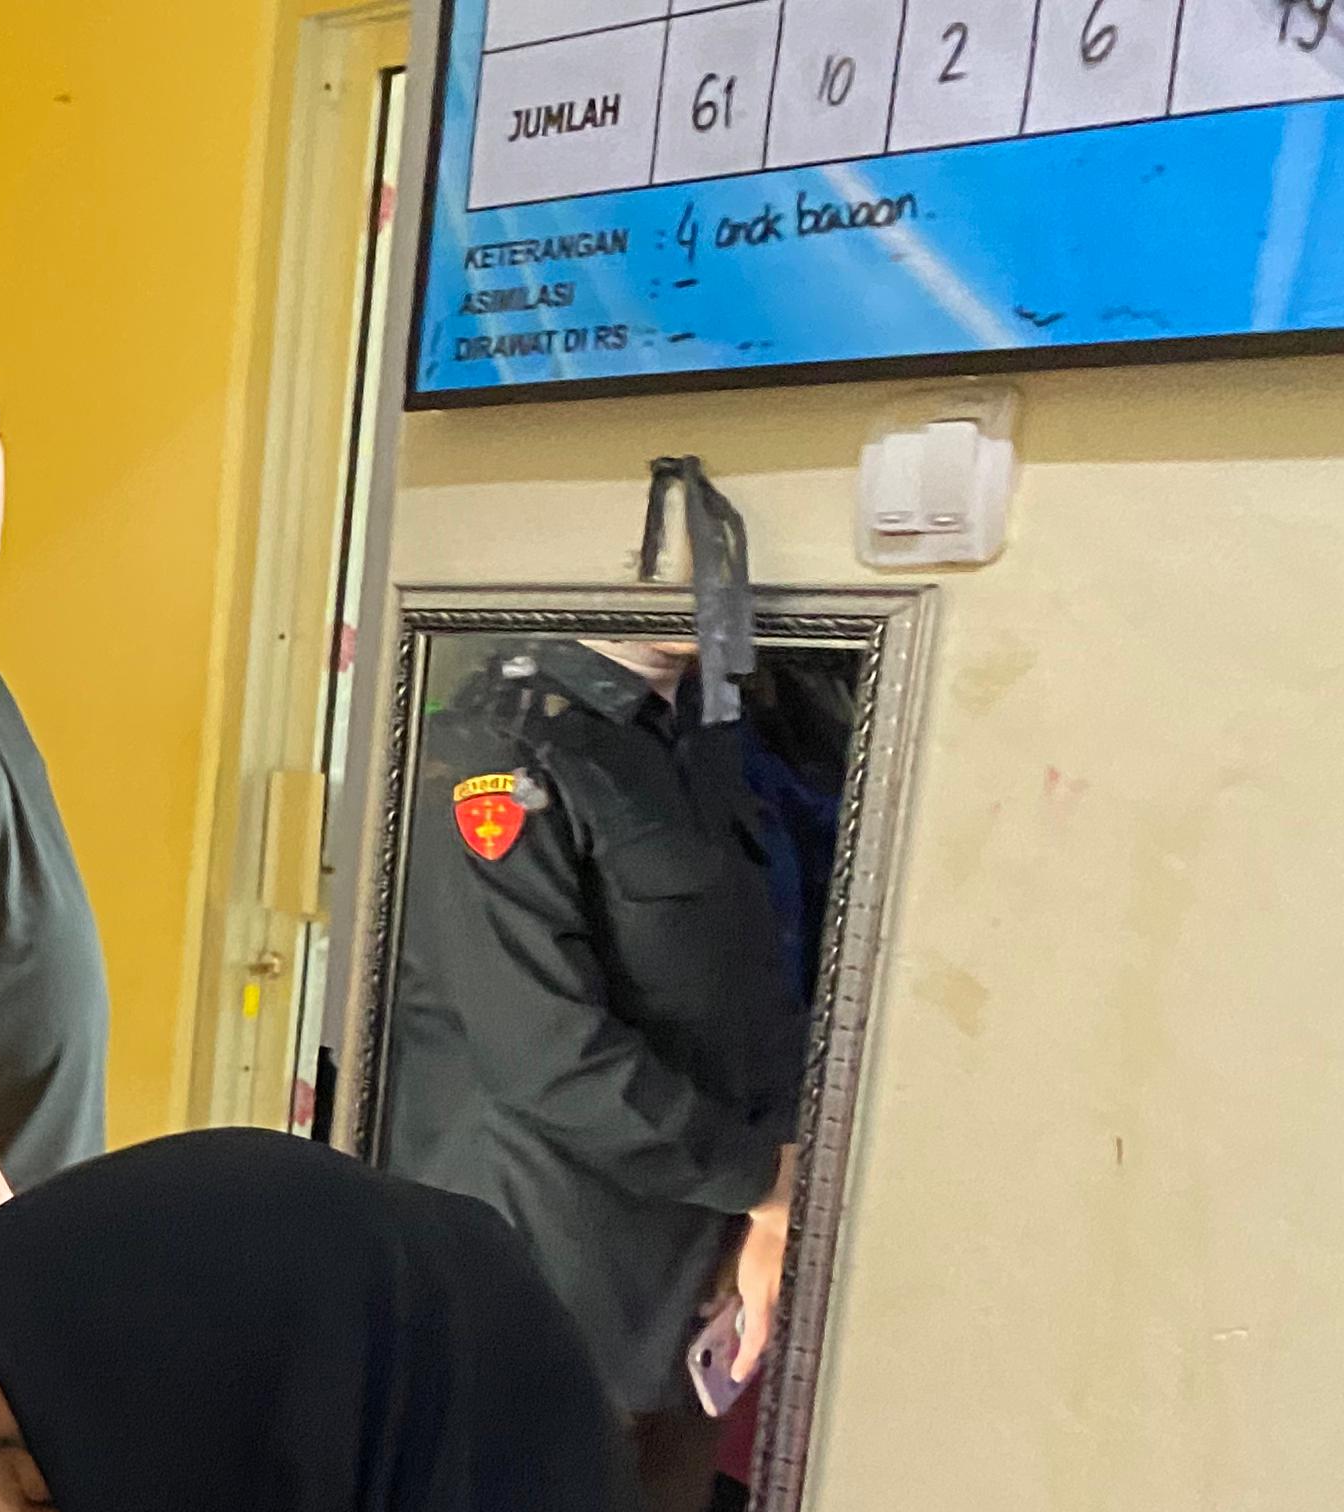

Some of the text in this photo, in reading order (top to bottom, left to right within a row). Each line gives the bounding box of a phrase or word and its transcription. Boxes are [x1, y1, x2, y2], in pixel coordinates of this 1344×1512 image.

[938, 22, 968, 82] 2
[1081, 0, 1118, 67] 6
[692, 73, 737, 132] 61
[818, 53, 856, 105] 10
[509, 94, 621, 141] JUMLAH
[465, 229, 629, 268] KETERANGAN
[455, 324, 629, 361] DIRAWAT DI RS
